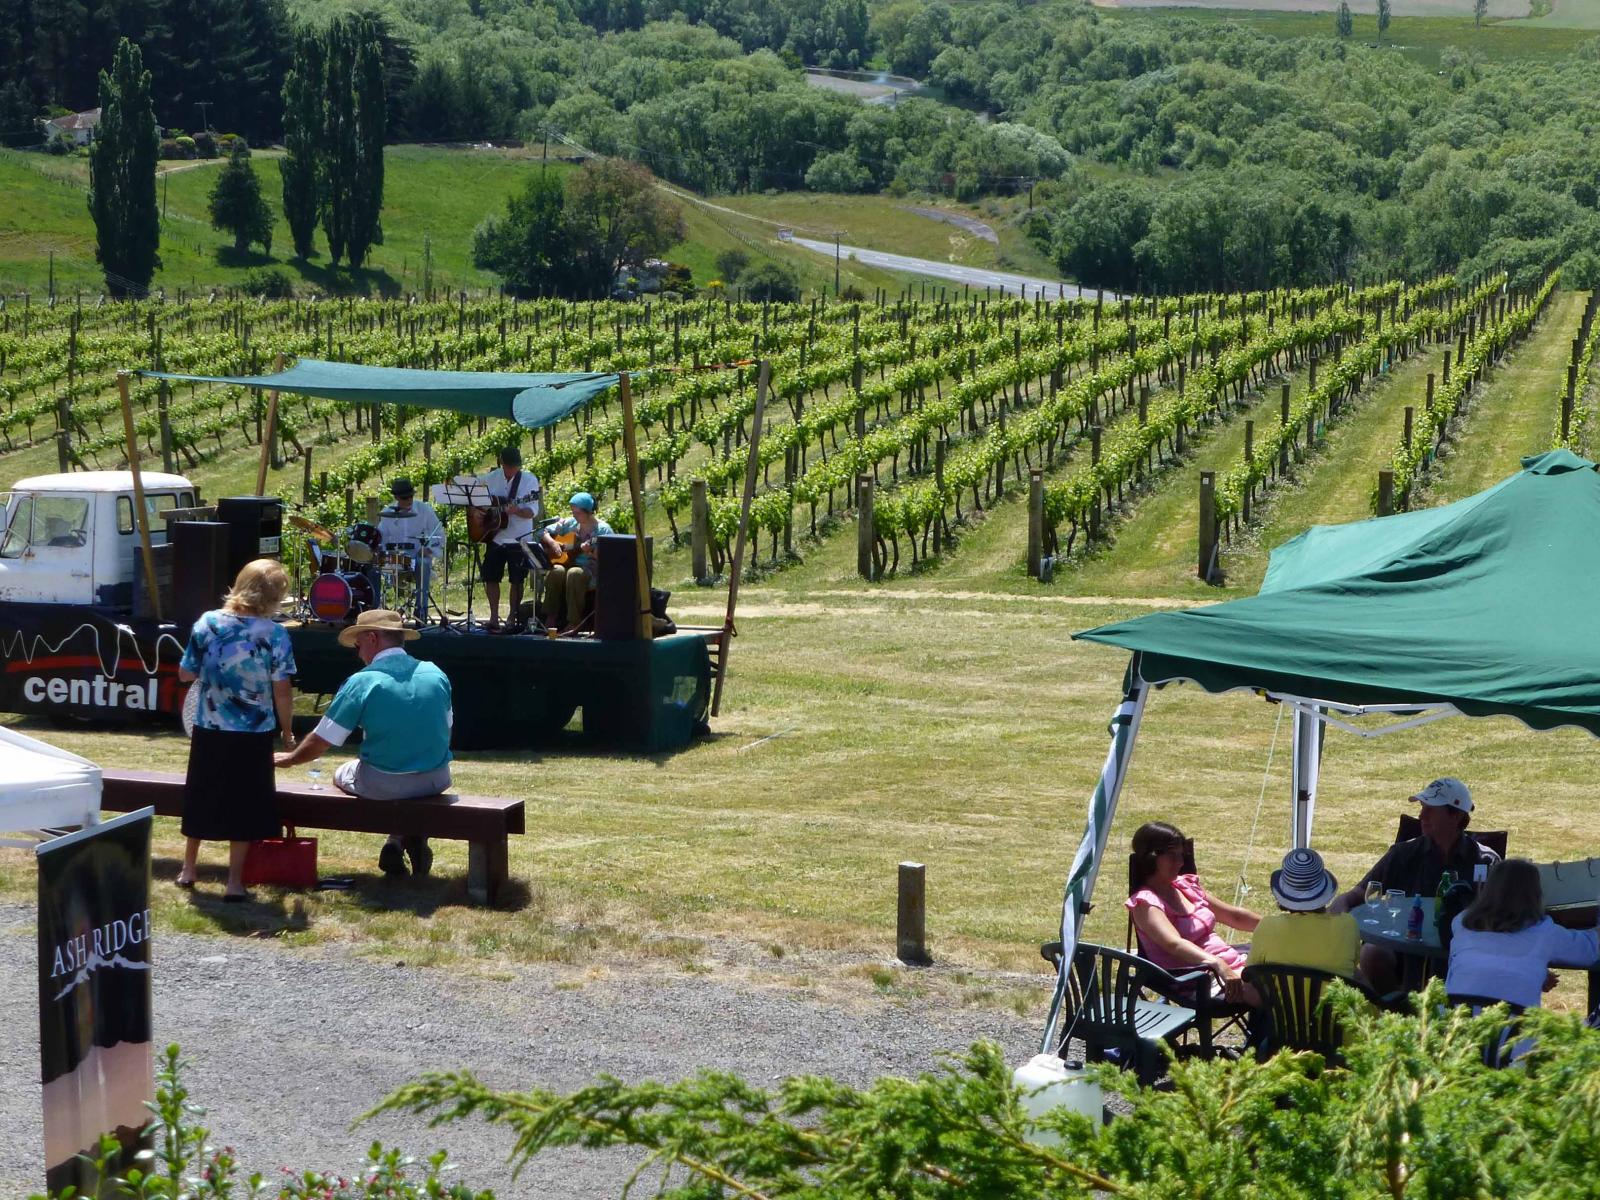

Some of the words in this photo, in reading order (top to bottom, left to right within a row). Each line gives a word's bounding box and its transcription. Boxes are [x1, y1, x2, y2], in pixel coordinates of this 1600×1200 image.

[24, 675, 158, 711] central
[50, 934, 87, 978] ASH
[92, 908, 151, 957] RIDGE
